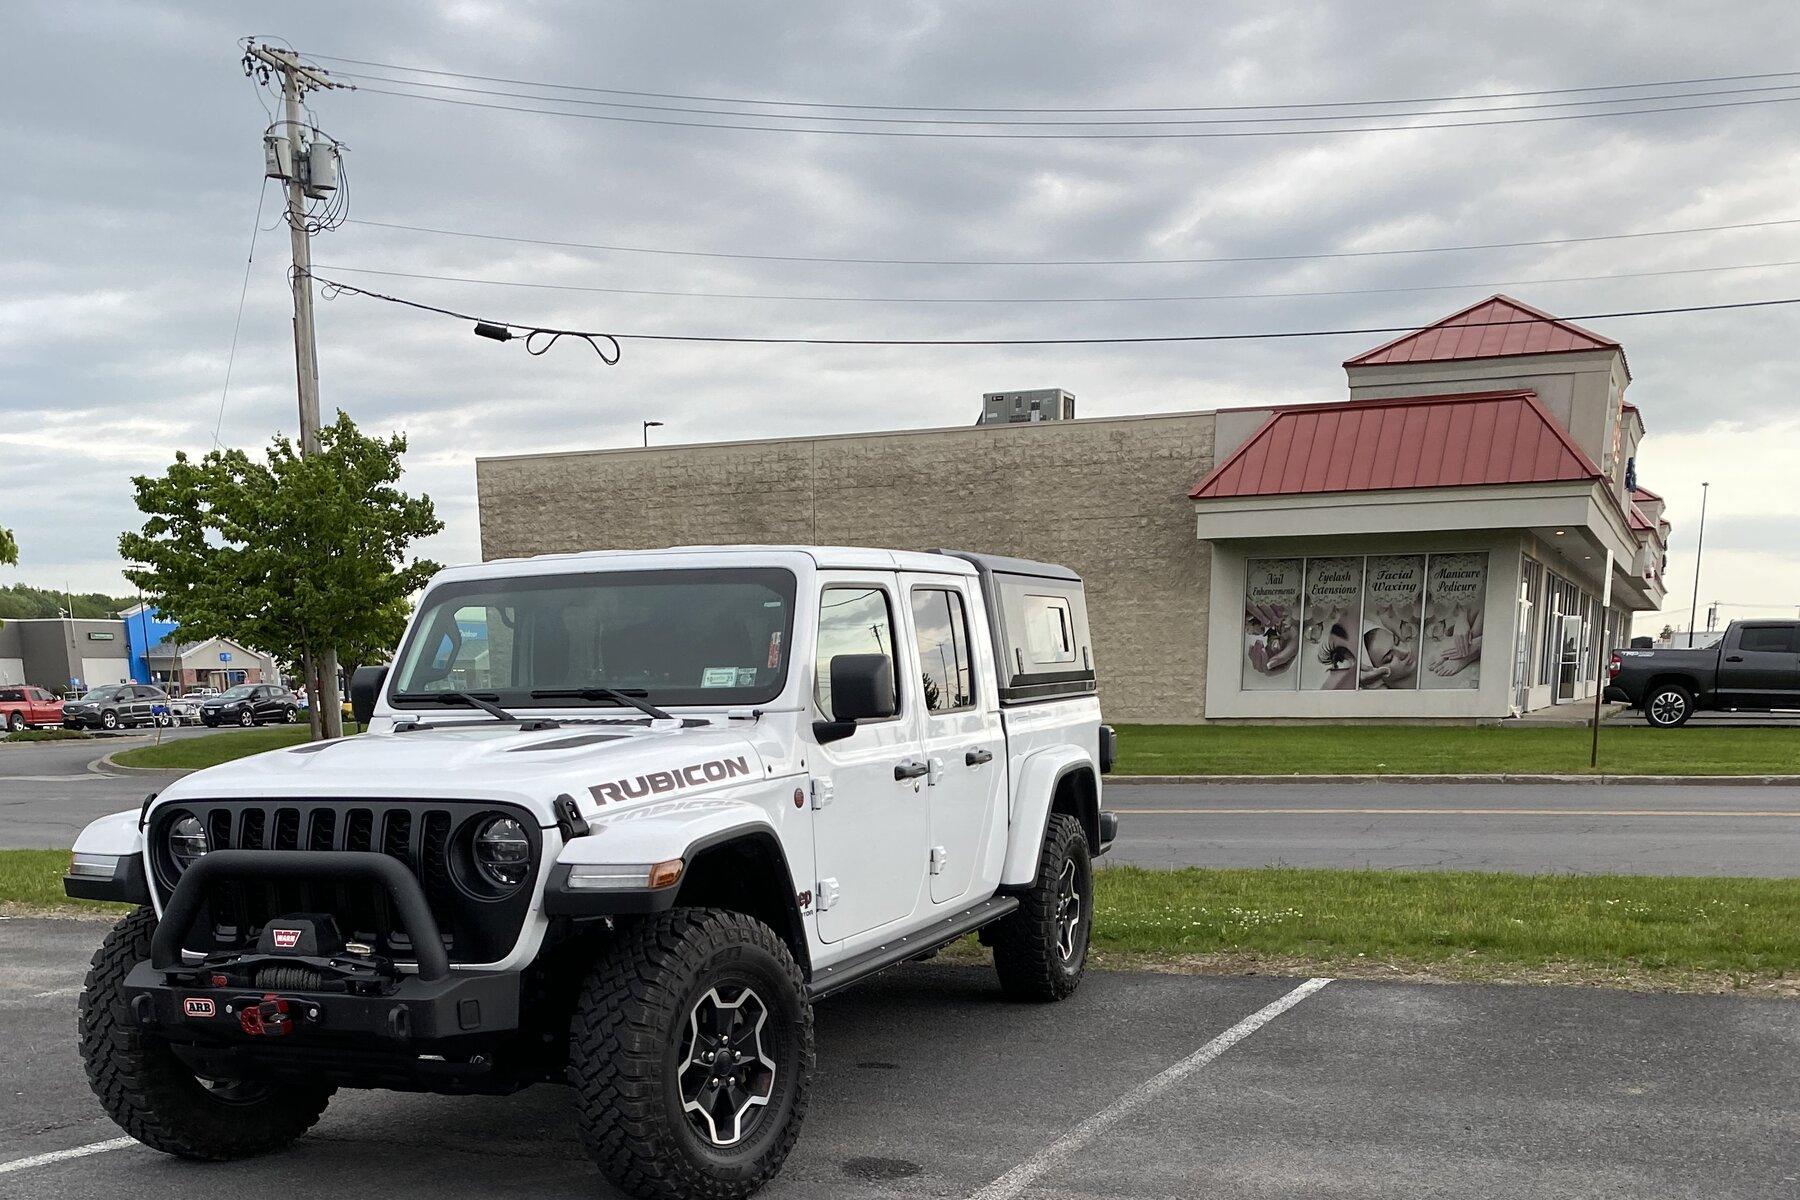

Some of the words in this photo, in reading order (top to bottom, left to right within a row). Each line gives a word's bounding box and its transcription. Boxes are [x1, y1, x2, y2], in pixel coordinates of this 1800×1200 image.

[1266, 573, 1284, 585] Nail
[1319, 571, 1351, 584] Eyelash
[1377, 569, 1414, 580] Facial
[1435, 568, 1481, 579] Manicure
[1253, 587, 1296, 596] Enhancements
[1312, 584, 1357, 595] Extensions
[1372, 581, 1417, 593] Waxing
[1437, 581, 1477, 592] Pedicure
[588, 756, 749, 806] RUBICON
[188, 1003, 211, 1012] ARB
